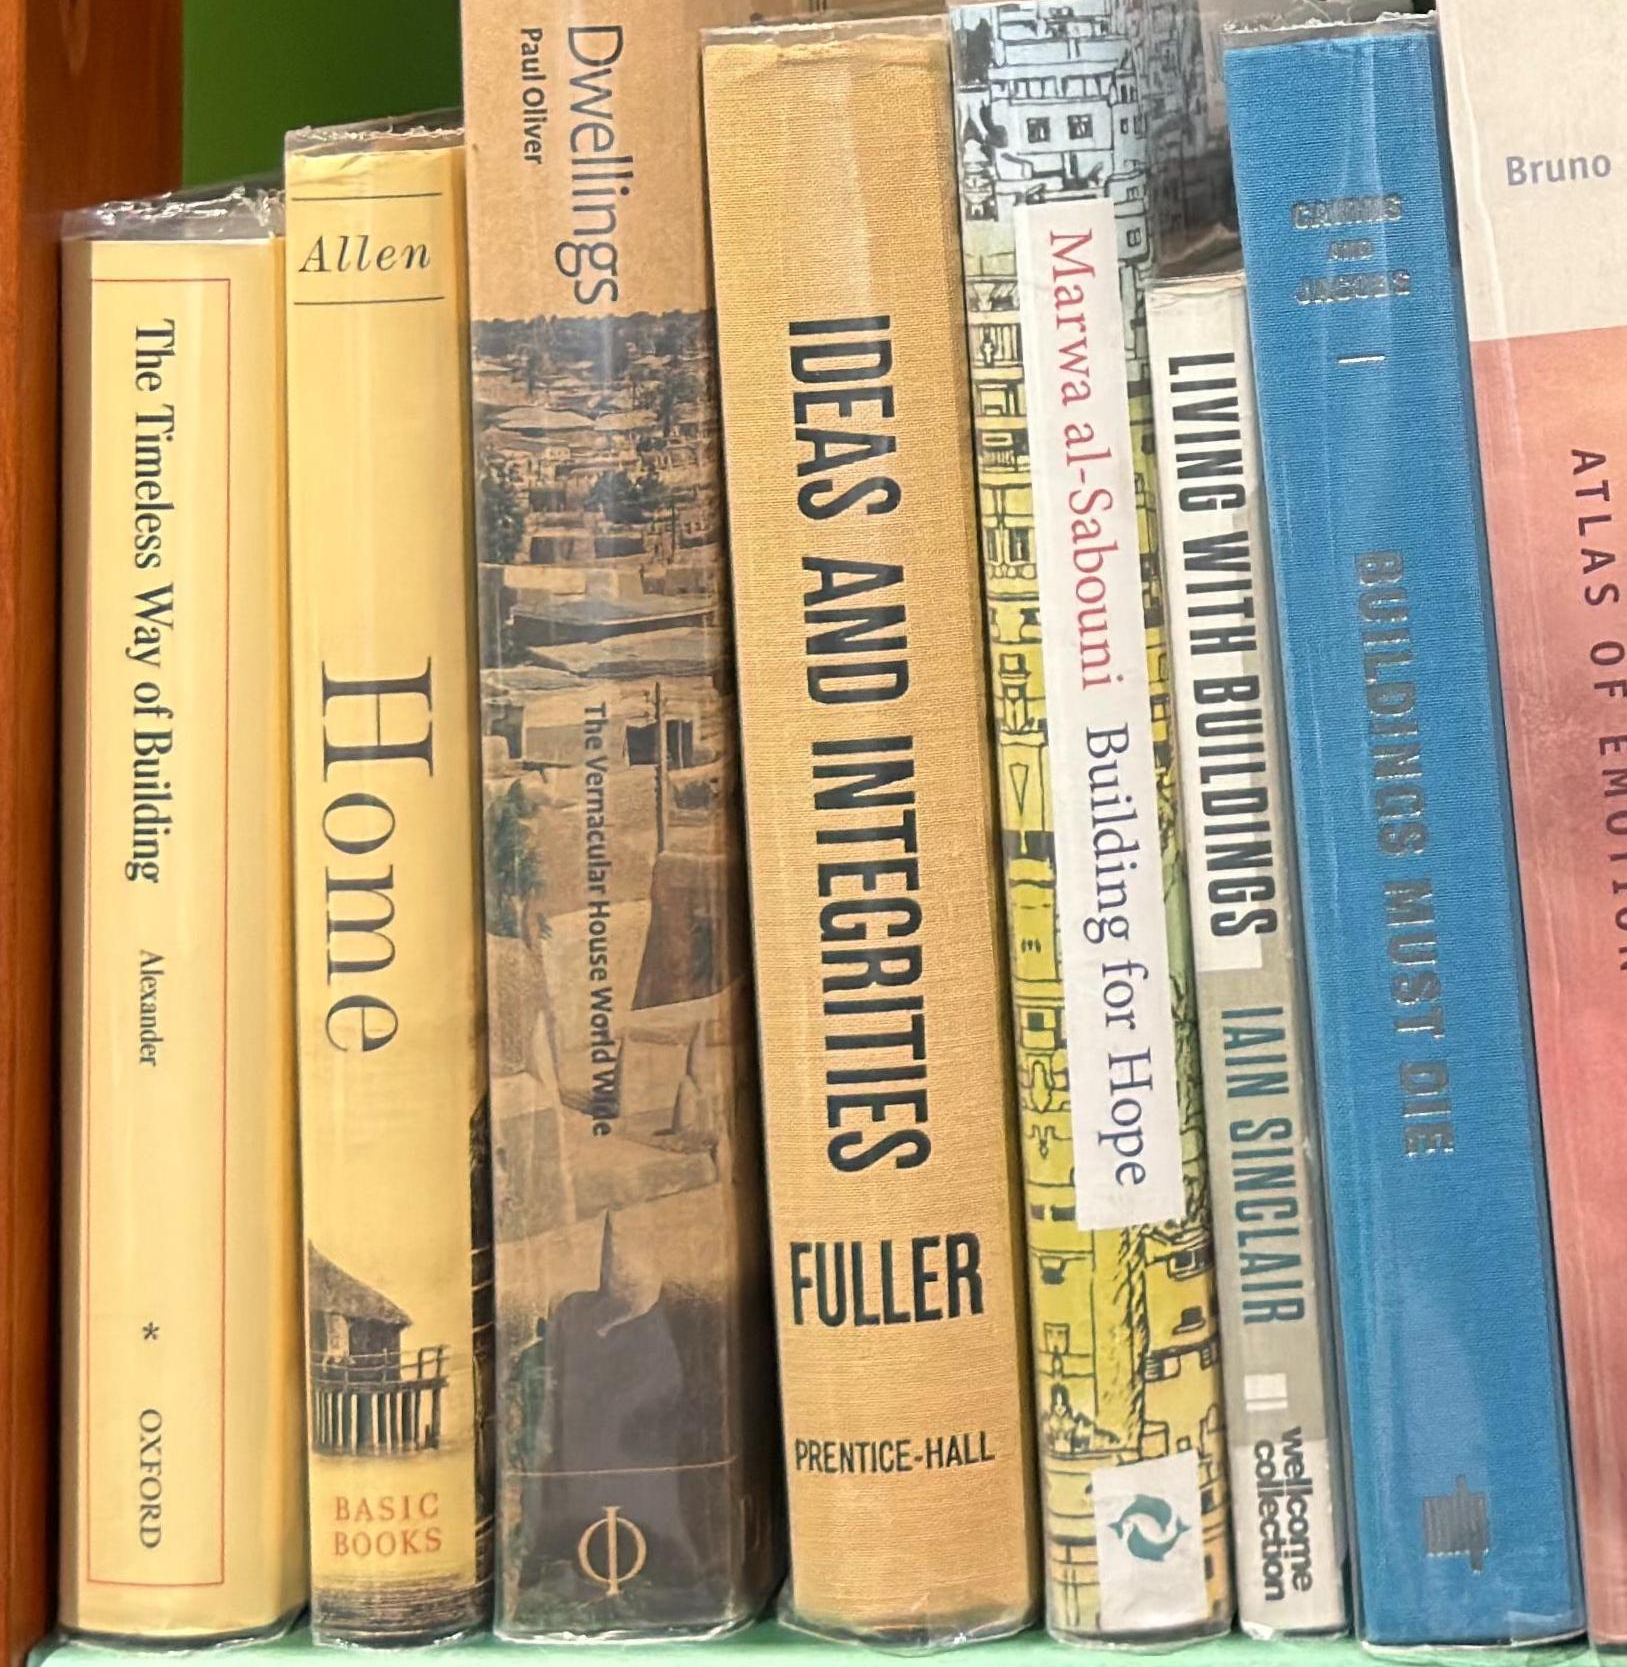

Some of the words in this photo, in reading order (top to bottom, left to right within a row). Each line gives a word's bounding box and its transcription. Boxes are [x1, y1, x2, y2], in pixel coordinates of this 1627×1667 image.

[520, 28, 544, 80] Paul
[521, 87, 547, 165] Oliver
[555, 24, 634, 304] Dwellings
[1505, 152, 1613, 187] Bruno
[298, 235, 433, 274] Allen
[1048, 228, 1094, 408] Marwa
[134, 318, 177, 393] The
[788, 315, 902, 520] IDEAS
[133, 403, 178, 570] Timeless
[1169, 352, 1245, 511] LIVING
[1062, 422, 1124, 691] al-Sabouni
[1183, 532, 1256, 661] WITH
[1570, 447, 1622, 608] ATLAS
[126, 582, 175, 669] Way
[800, 559, 912, 704] AND
[131, 682, 173, 717] of
[585, 702, 606, 748] The
[1358, 551, 1430, 858] BUILDINGS
[125, 728, 174, 883] Building
[321, 656, 434, 1053] Home
[584, 755, 610, 895] Vernacular
[1082, 721, 1141, 944] Building
[1193, 674, 1278, 939] BUILDINGS
[138, 948, 165, 1067] Alexander
[588, 900, 611, 981] House
[811, 734, 932, 1173] INTEGRITIES
[1100, 956, 1149, 1029] for
[1384, 877, 1446, 1041] MUST
[589, 984, 616, 1063] World
[1221, 1005, 1285, 1097] IAIN
[1098, 1045, 1154, 1188] Hope
[1402, 1058, 1457, 1158] DIE
[789, 1233, 984, 1327] FULLER
[1227, 1118, 1304, 1325] SINCLAIR
[138, 1409, 164, 1549] OXFORD
[334, 1493, 441, 1523] BASIC
[794, 1437, 995, 1473] PRENTICE-HALL
[1249, 1438, 1285, 1601] collection
[1282, 1426, 1314, 1592] wellcome
[333, 1526, 444, 1557] BOOKS
